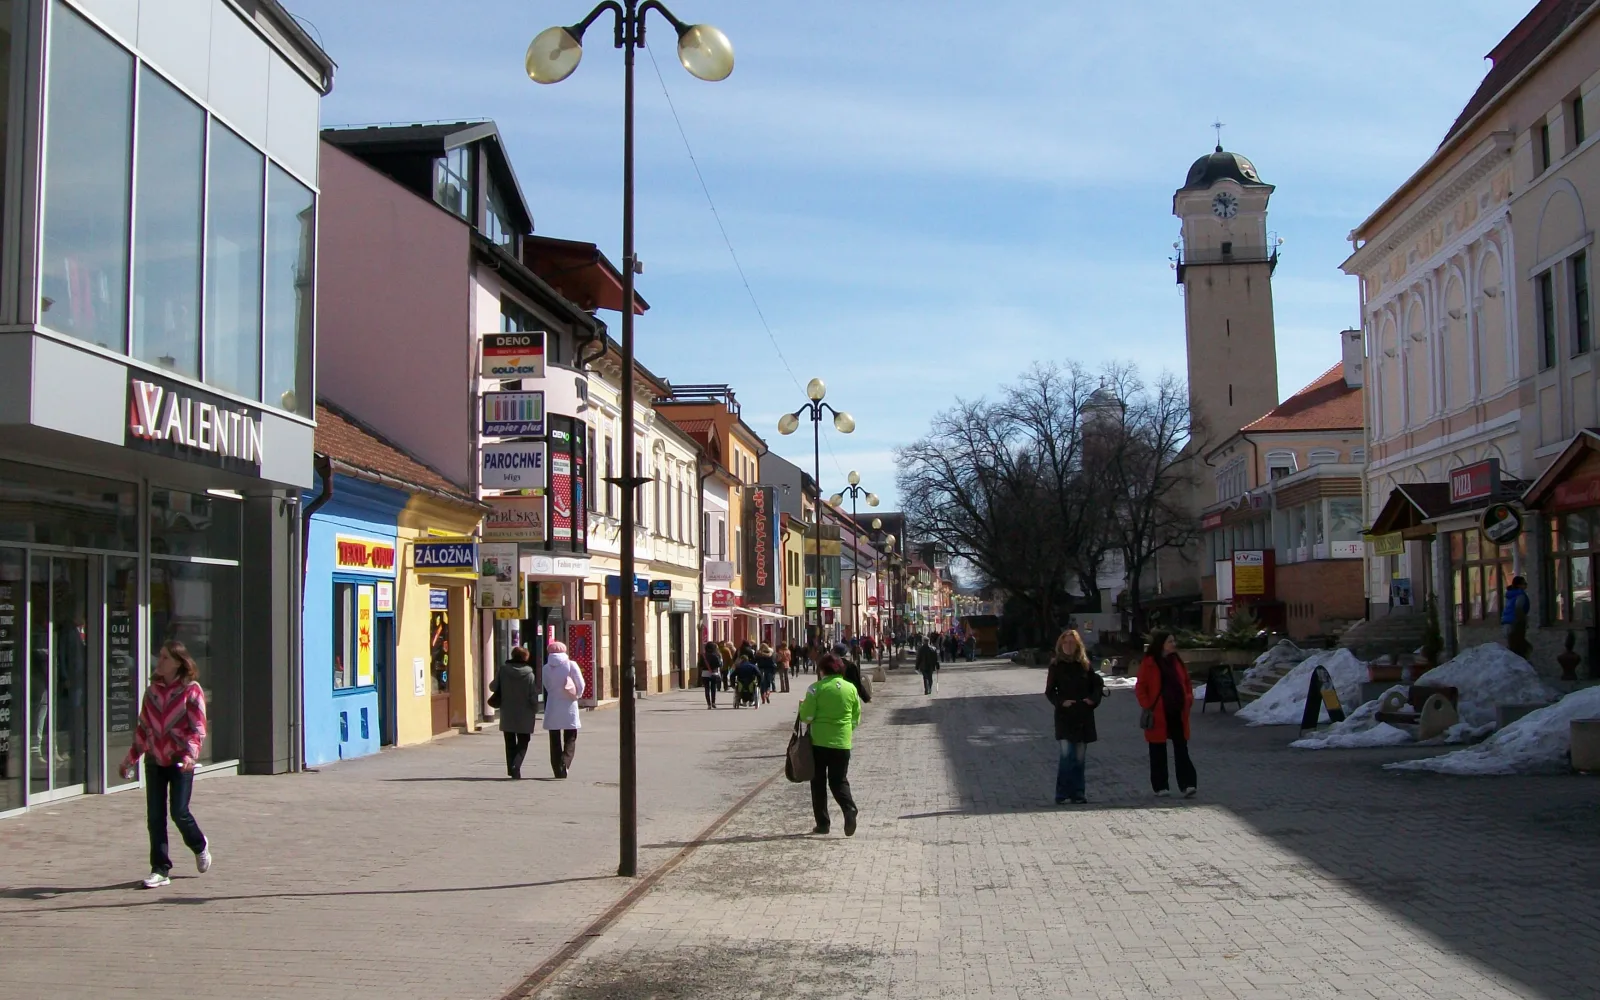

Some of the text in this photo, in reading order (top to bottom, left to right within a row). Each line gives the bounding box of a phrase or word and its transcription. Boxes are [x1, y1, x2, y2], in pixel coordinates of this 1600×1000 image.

[496, 336, 531, 346] DENO
[491, 366, 535, 375] GOLD-ECK
[486, 422, 543, 434] papier plus
[484, 452, 542, 469] PAROCHNE
[503, 473, 521, 483] Wigs
[1453, 473, 1472, 497] PIZZA
[752, 489, 766, 587] sportrysy.sk
[415, 545, 473, 564] ZÁLOŽŇA
